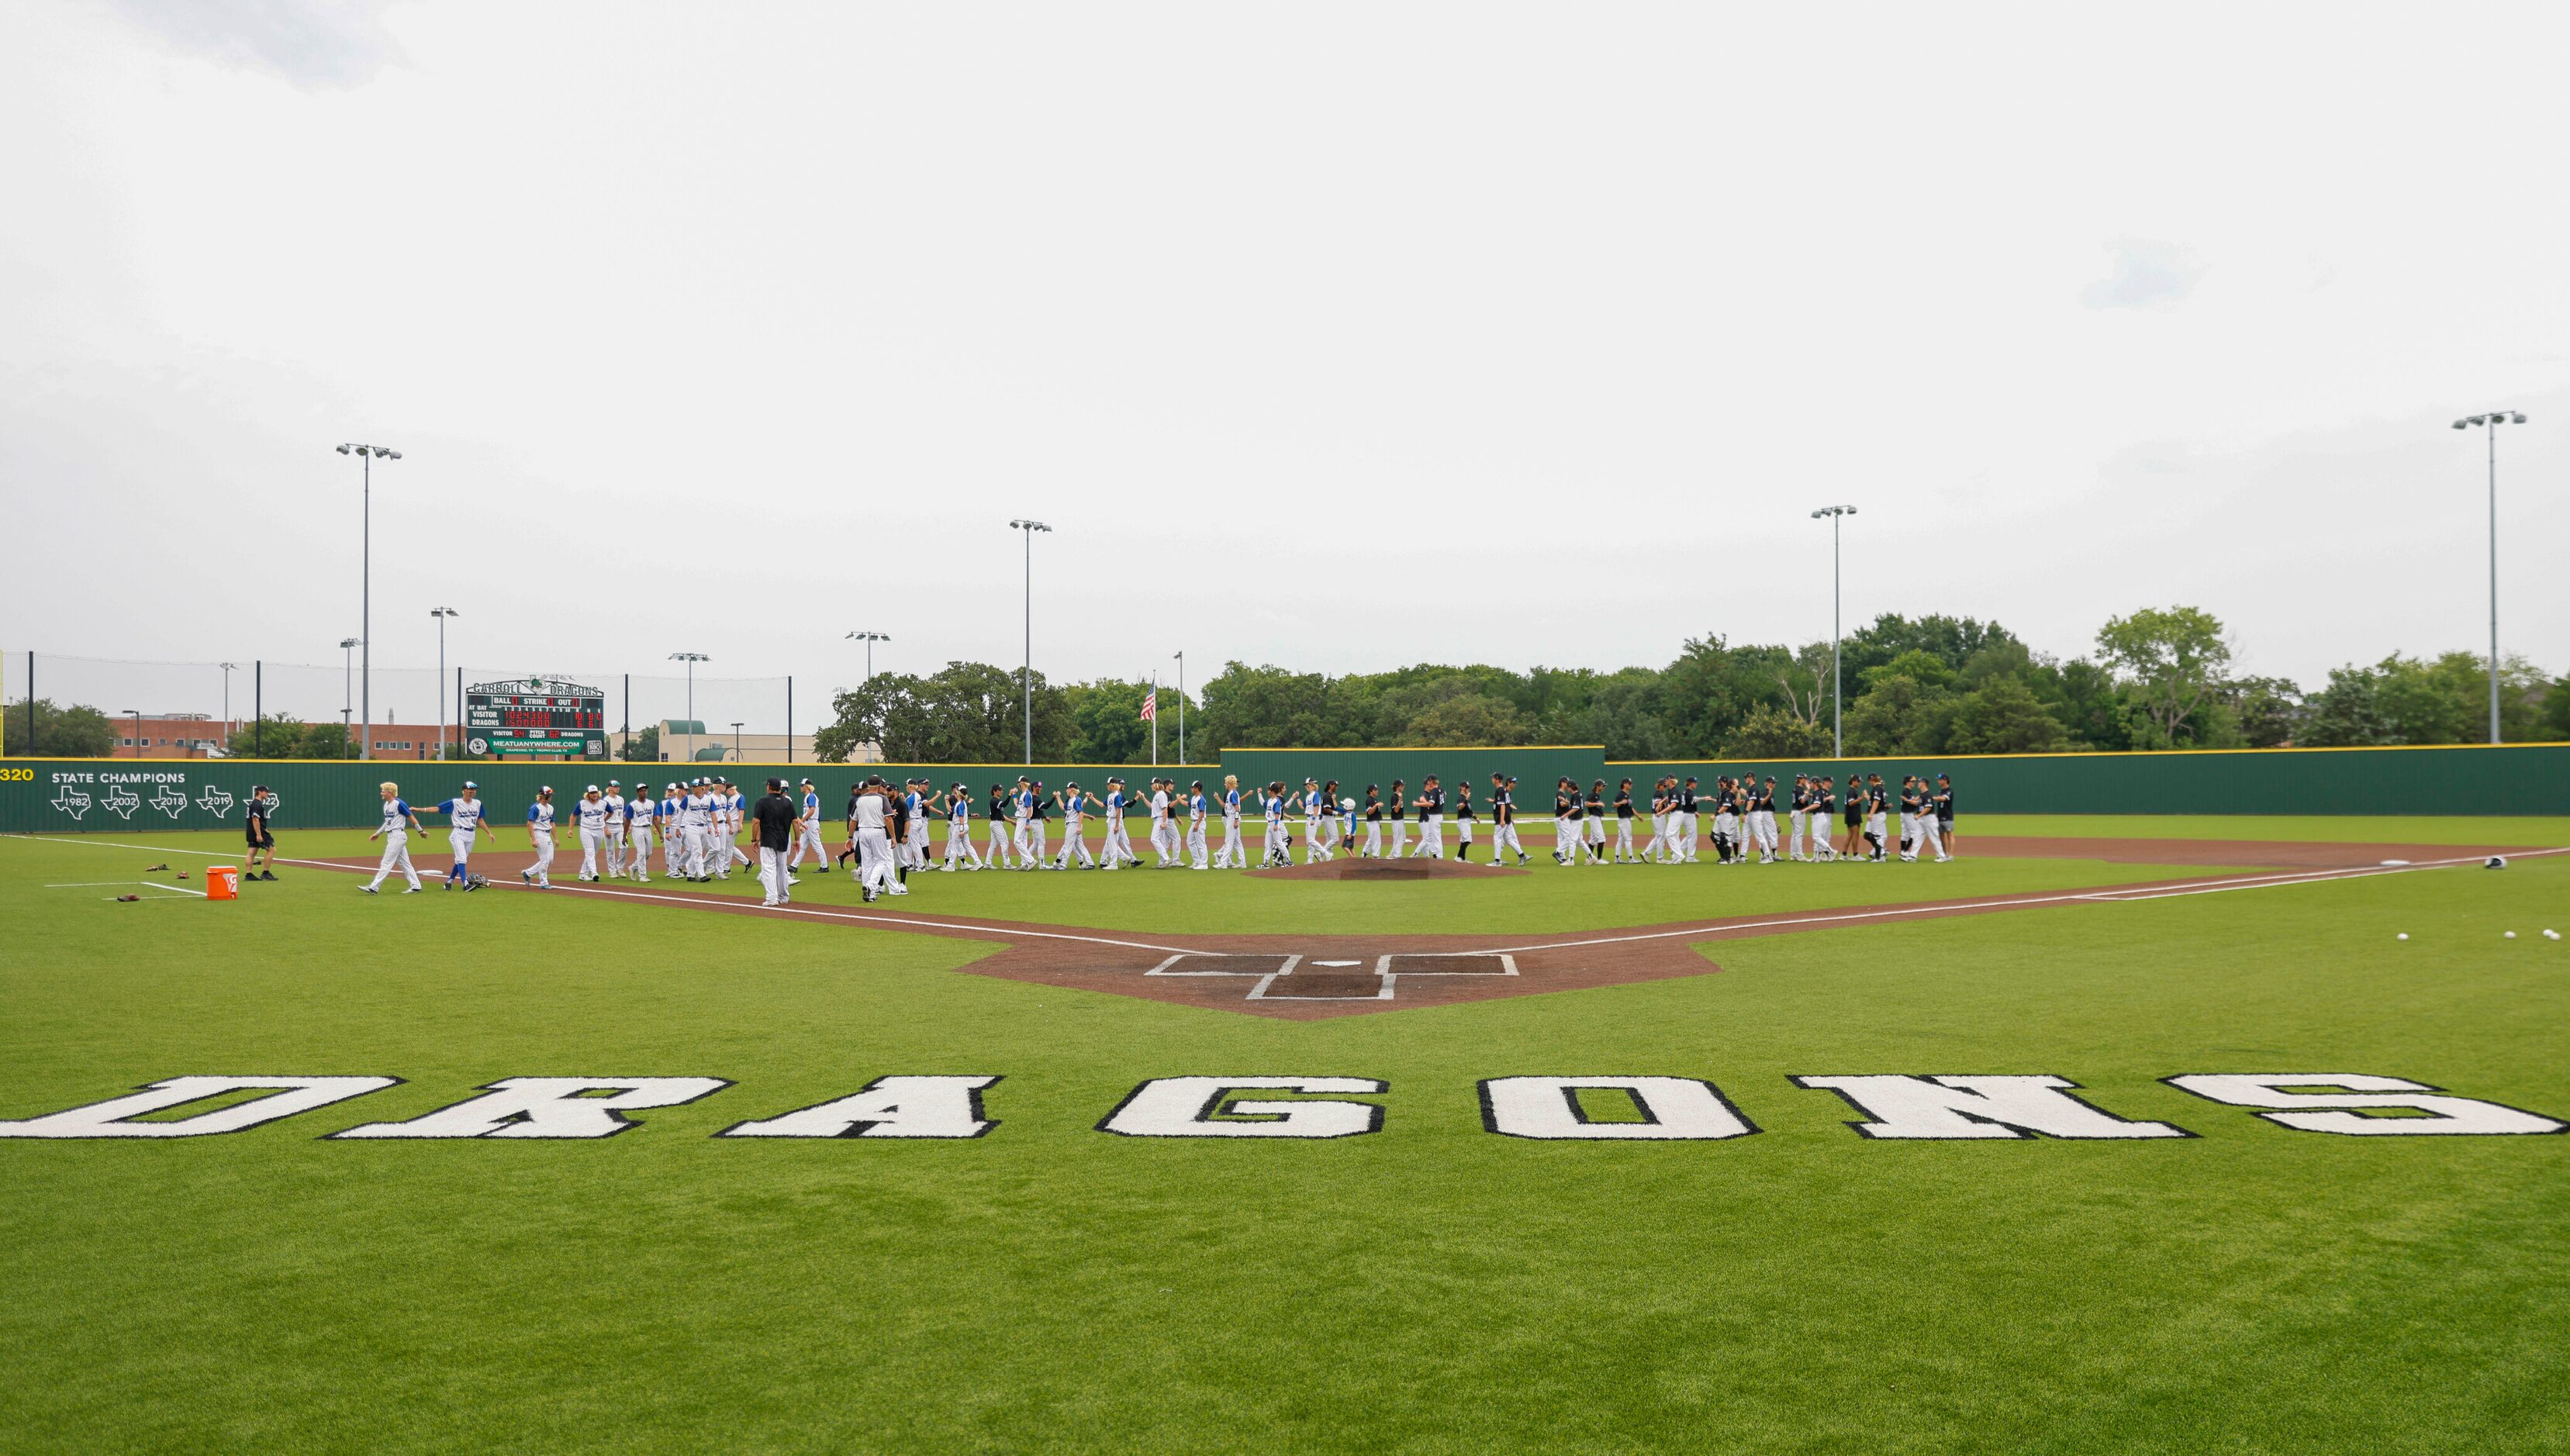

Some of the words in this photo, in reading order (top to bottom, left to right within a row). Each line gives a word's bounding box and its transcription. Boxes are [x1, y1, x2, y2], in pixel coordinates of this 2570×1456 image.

[473, 683, 522, 693] CARROLL
[551, 685, 598, 696] DRAGONS
[0, 768, 34, 781] 320
[52, 774, 94, 783] STATE
[100, 774, 185, 783] CHAMPIONS
[64, 798, 88, 806] 1982
[112, 798, 136, 806] 2002
[207, 797, 230, 806] 2019
[230, 875, 237, 884] G
[0, 1075, 2570, 1141] DRAGONS
